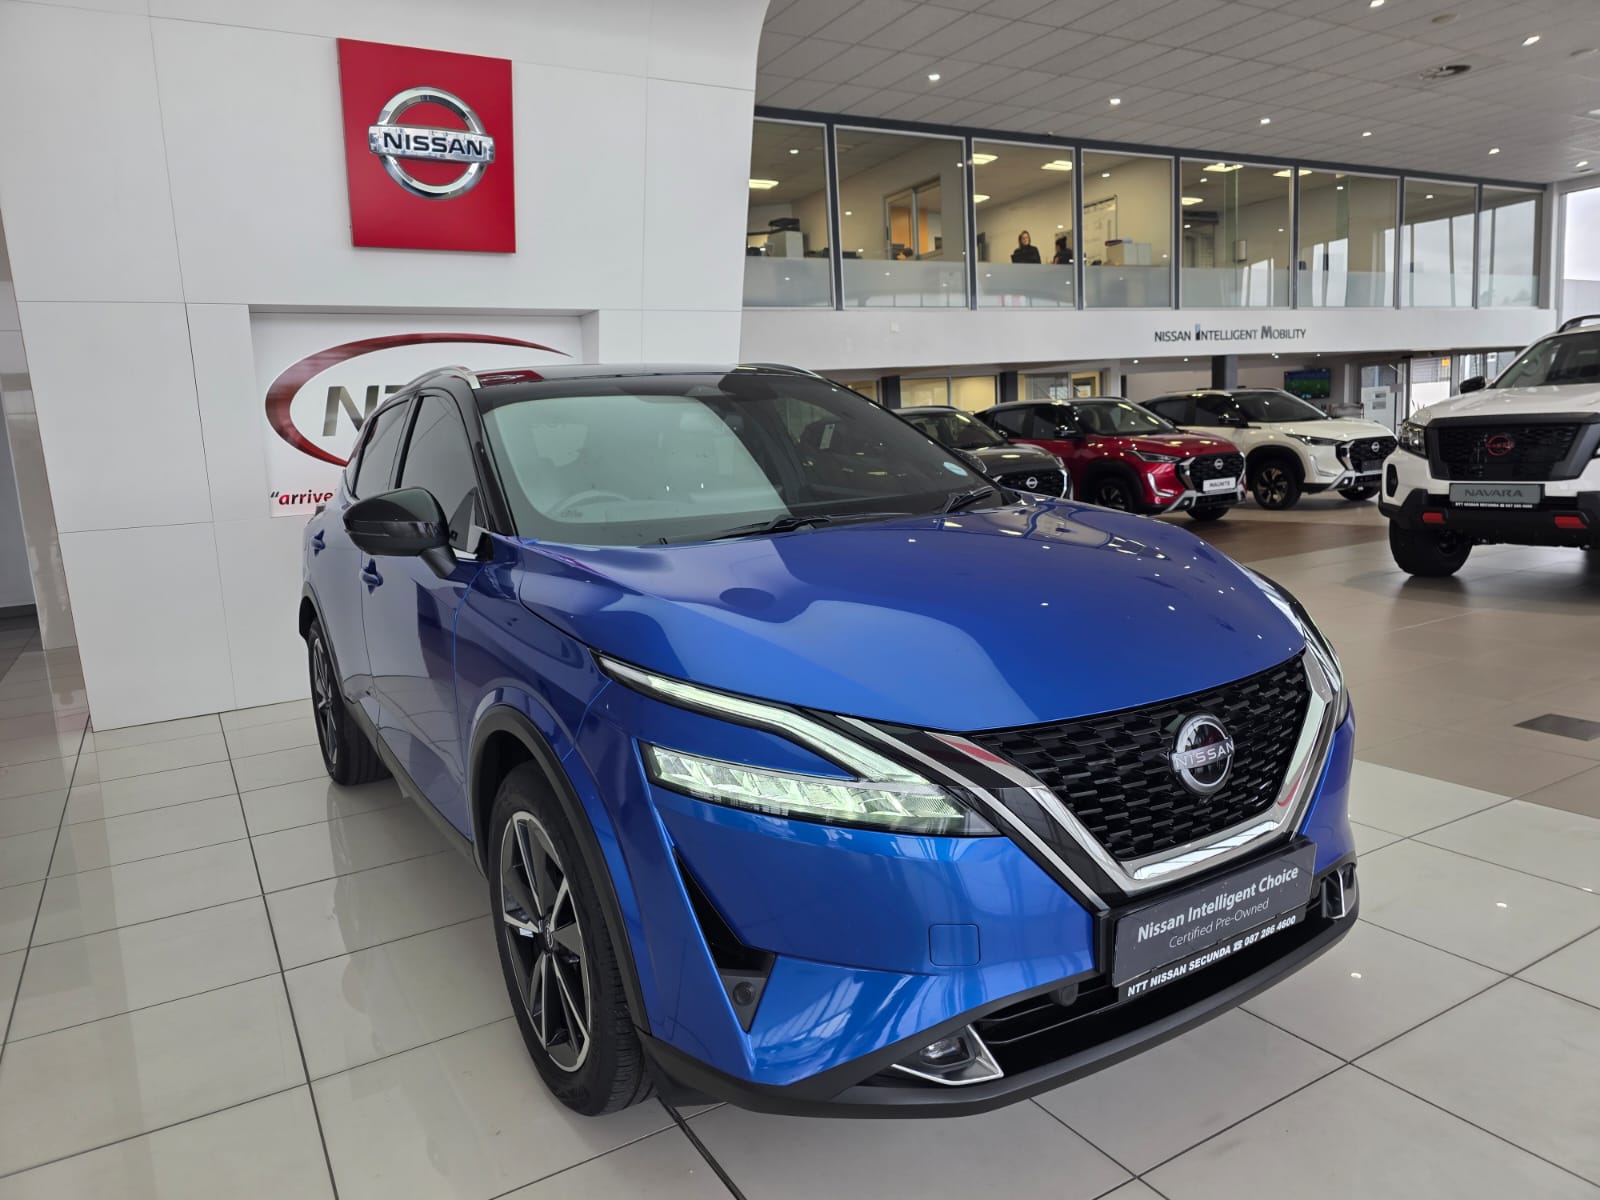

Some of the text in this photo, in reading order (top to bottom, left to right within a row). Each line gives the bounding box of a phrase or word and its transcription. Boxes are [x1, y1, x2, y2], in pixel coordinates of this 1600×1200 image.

[383, 132, 483, 156] NISSAN
[1154, 330, 1191, 342] NISSAN
[1464, 489, 1523, 497] NAVARA
[1175, 742, 1234, 768] NISSAN
[1137, 866, 1299, 943] Nissan Intelligent Choice
[1169, 898, 1270, 949] Certified Pre-Owned
[1127, 979, 1149, 997] NTT
[1149, 964, 1187, 986] NISSAN
[1188, 944, 1231, 971] SECUNDA
[1244, 931, 1260, 946] 087
